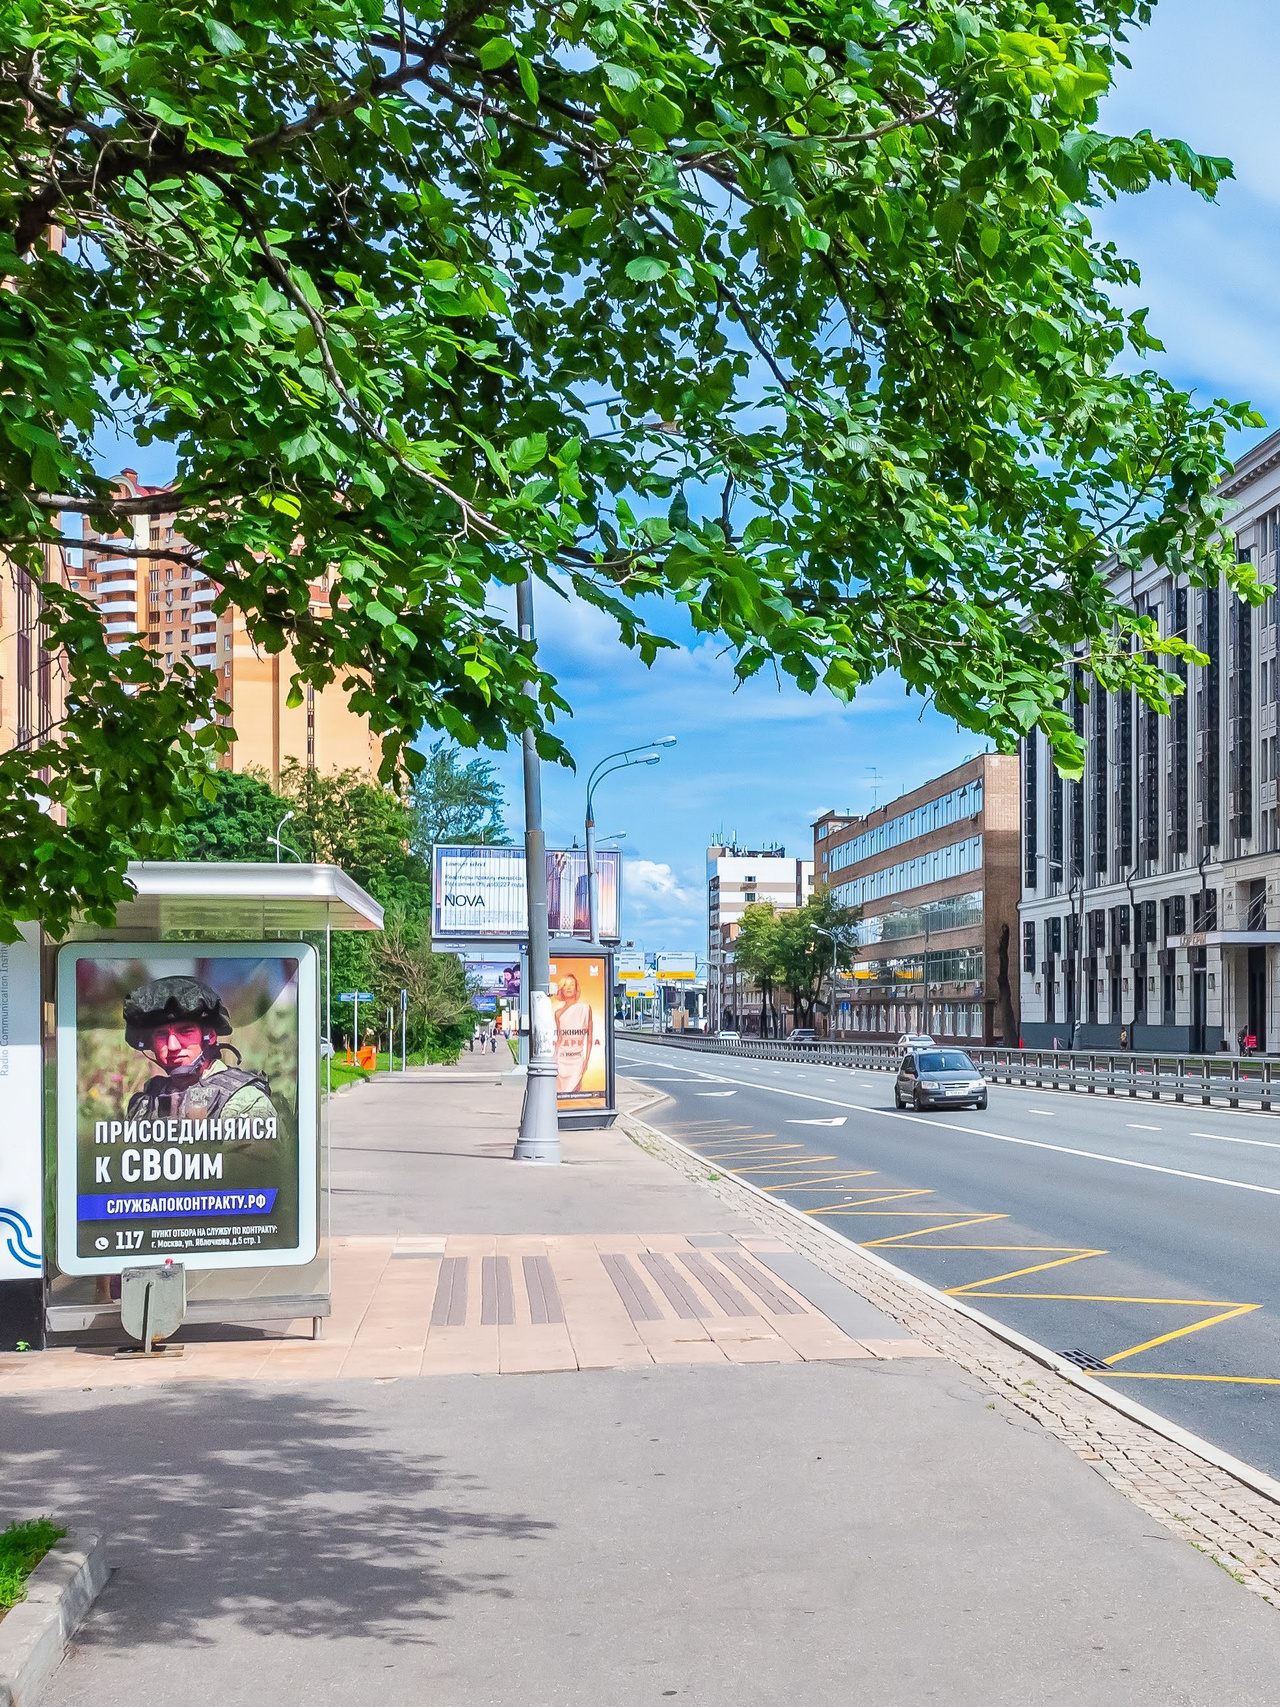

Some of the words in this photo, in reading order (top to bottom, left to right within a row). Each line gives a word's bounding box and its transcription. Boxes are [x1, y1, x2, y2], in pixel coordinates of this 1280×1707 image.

[444, 894, 485, 906] NOVA
[0, 976, 8, 1046] Communication
[0, 1050, 8, 1076] Radio
[96, 1113, 277, 1144] ПРИСОЕДИНЯЙСЯ
[107, 1194, 266, 1214] СЛУЖБАПОКОНТРАКТУ.РФ
[116, 1230, 144, 1250] 117
[152, 1230, 172, 1238] ПУНКТ
[172, 1228, 196, 1237] ОТБОРА
[197, 1228, 206, 1236] НА
[206, 1227, 232, 1236] СЛУЖБУ
[232, 1227, 241, 1235] ПО
[242, 1225, 278, 1234] КОНТРАКТУ:
[158, 1240, 184, 1248] Москва,
[195, 1238, 232, 1247] Яблочкова,
[232, 1237, 242, 1246] д.5
[244, 1237, 256, 1246] стр.
[257, 1236, 261, 1244] 1
